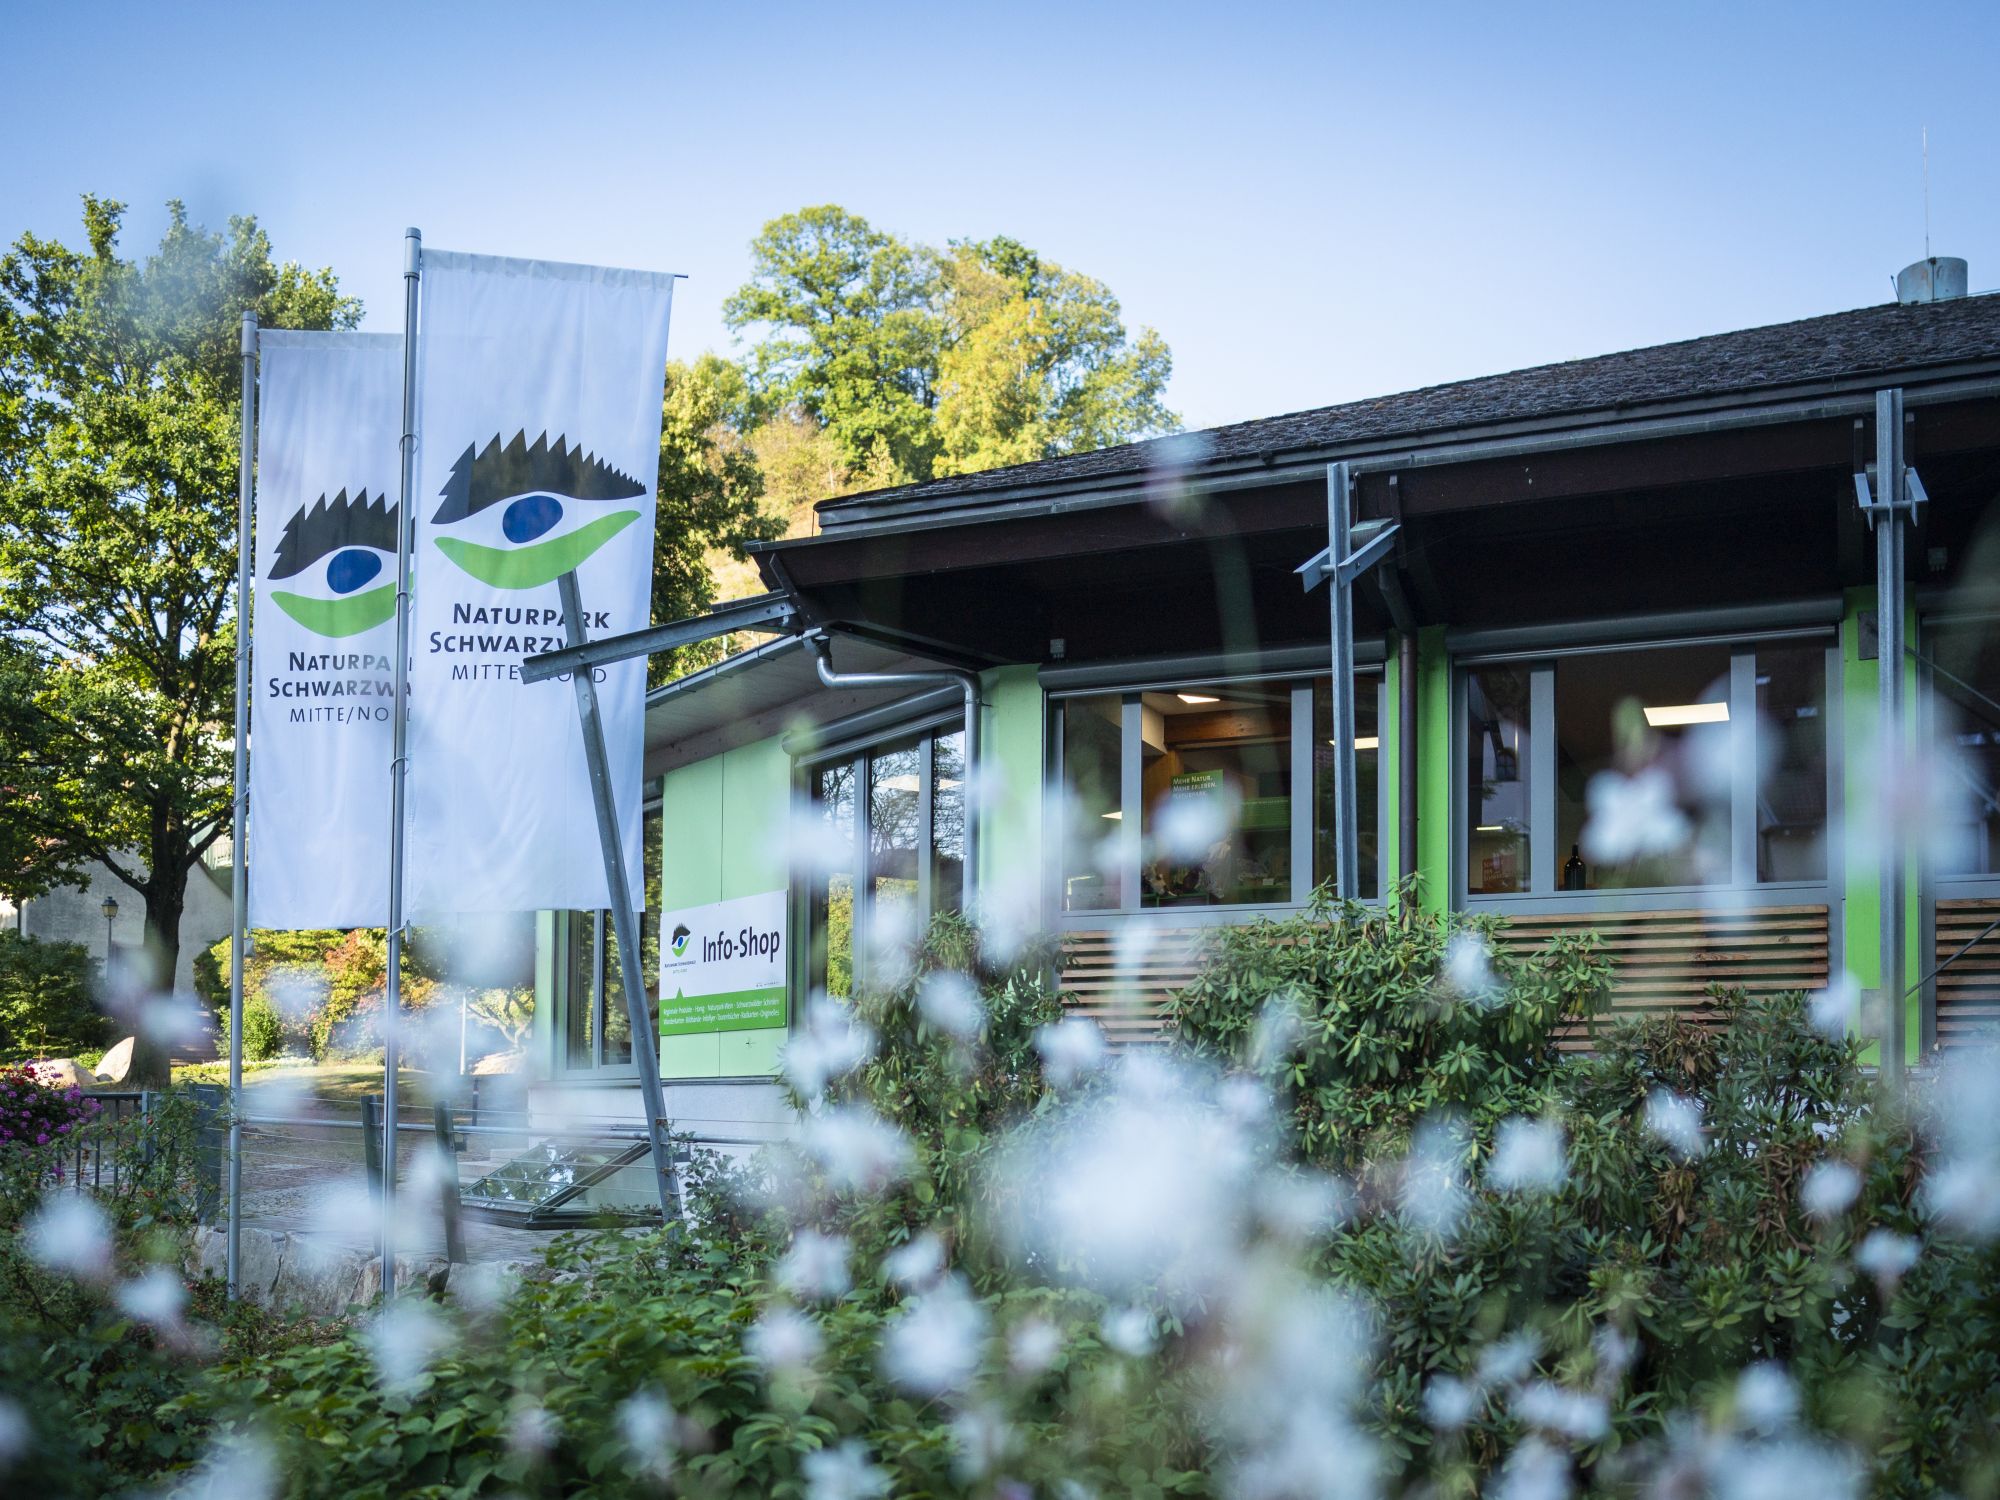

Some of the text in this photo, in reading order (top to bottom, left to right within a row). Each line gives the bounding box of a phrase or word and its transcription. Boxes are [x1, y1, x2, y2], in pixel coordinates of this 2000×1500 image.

[430, 632, 597, 653] SCHWARZ
[289, 652, 412, 671] NATURPA
[290, 706, 411, 724] MITTE/NO
[703, 926, 780, 963] Info-Shop
